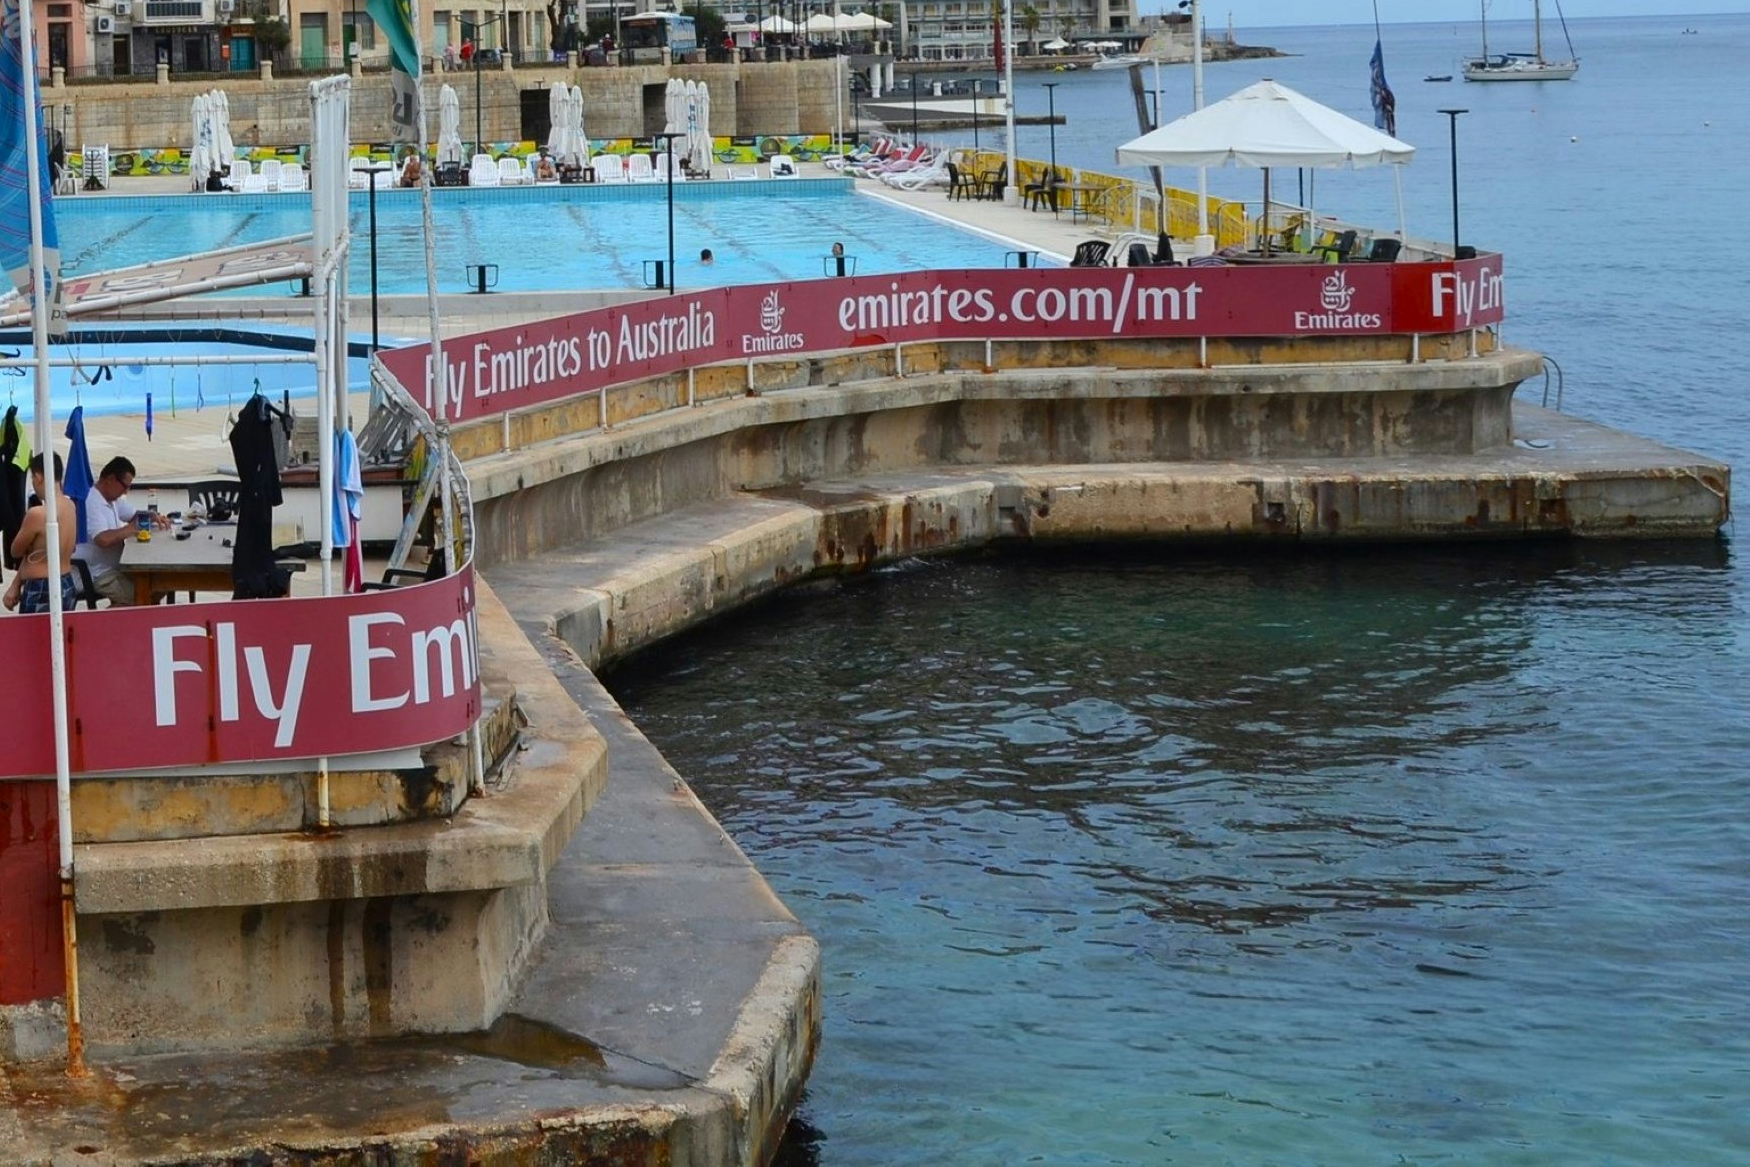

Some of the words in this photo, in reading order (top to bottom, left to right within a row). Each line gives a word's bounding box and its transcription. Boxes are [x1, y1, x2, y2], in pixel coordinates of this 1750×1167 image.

[839, 273, 1203, 333] emirates.com/mt
[1294, 311, 1381, 329] Emirates
[1432, 271, 1475, 326] Fly
[425, 351, 467, 418] Fly
[475, 331, 581, 398] Emirates
[588, 325, 610, 371] to
[616, 301, 715, 365] Australia
[742, 331, 804, 354] Emirates
[152, 622, 312, 748] Fly
